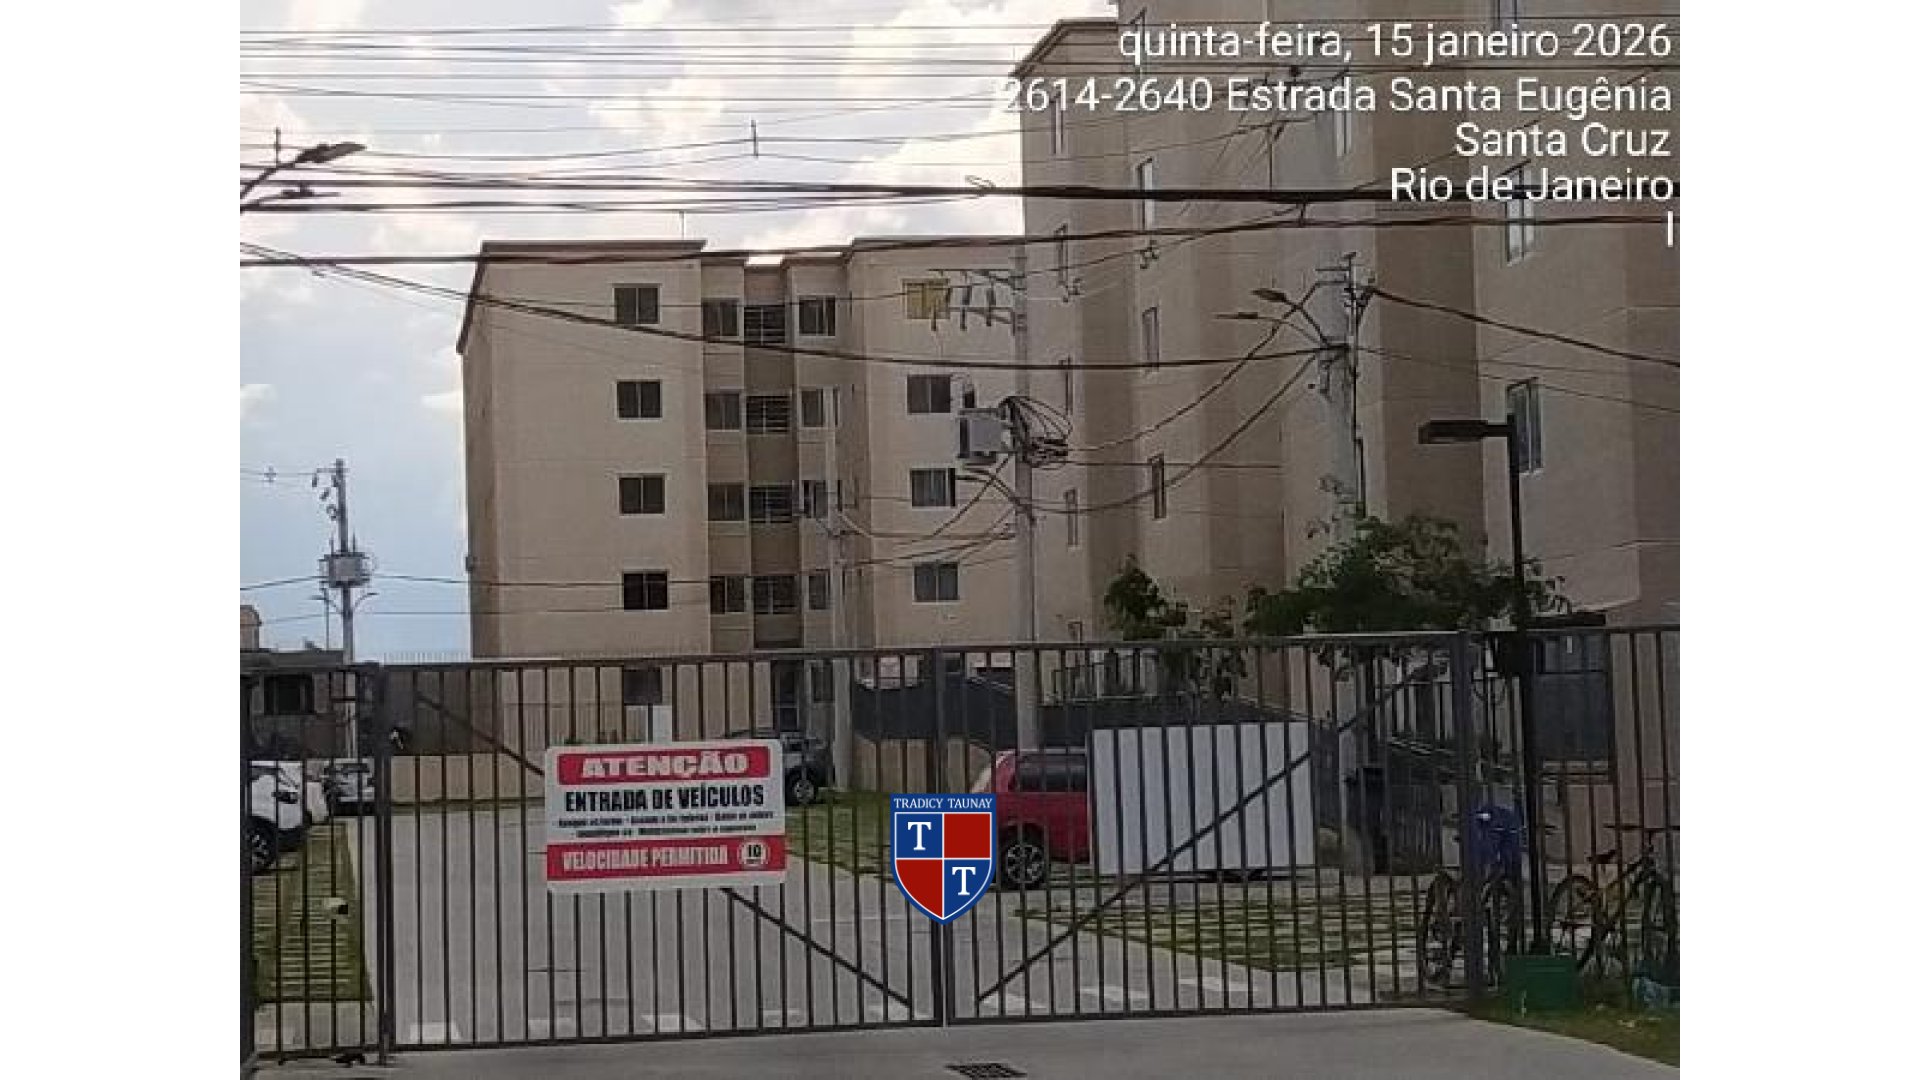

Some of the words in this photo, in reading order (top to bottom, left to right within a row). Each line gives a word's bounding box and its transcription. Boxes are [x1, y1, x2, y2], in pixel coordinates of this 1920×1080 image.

[582, 750, 749, 779] ATENÇÃO
[566, 790, 648, 812] ENTRADA
[652, 789, 673, 809] DE
[677, 783, 765, 808] VEÍCULOS
